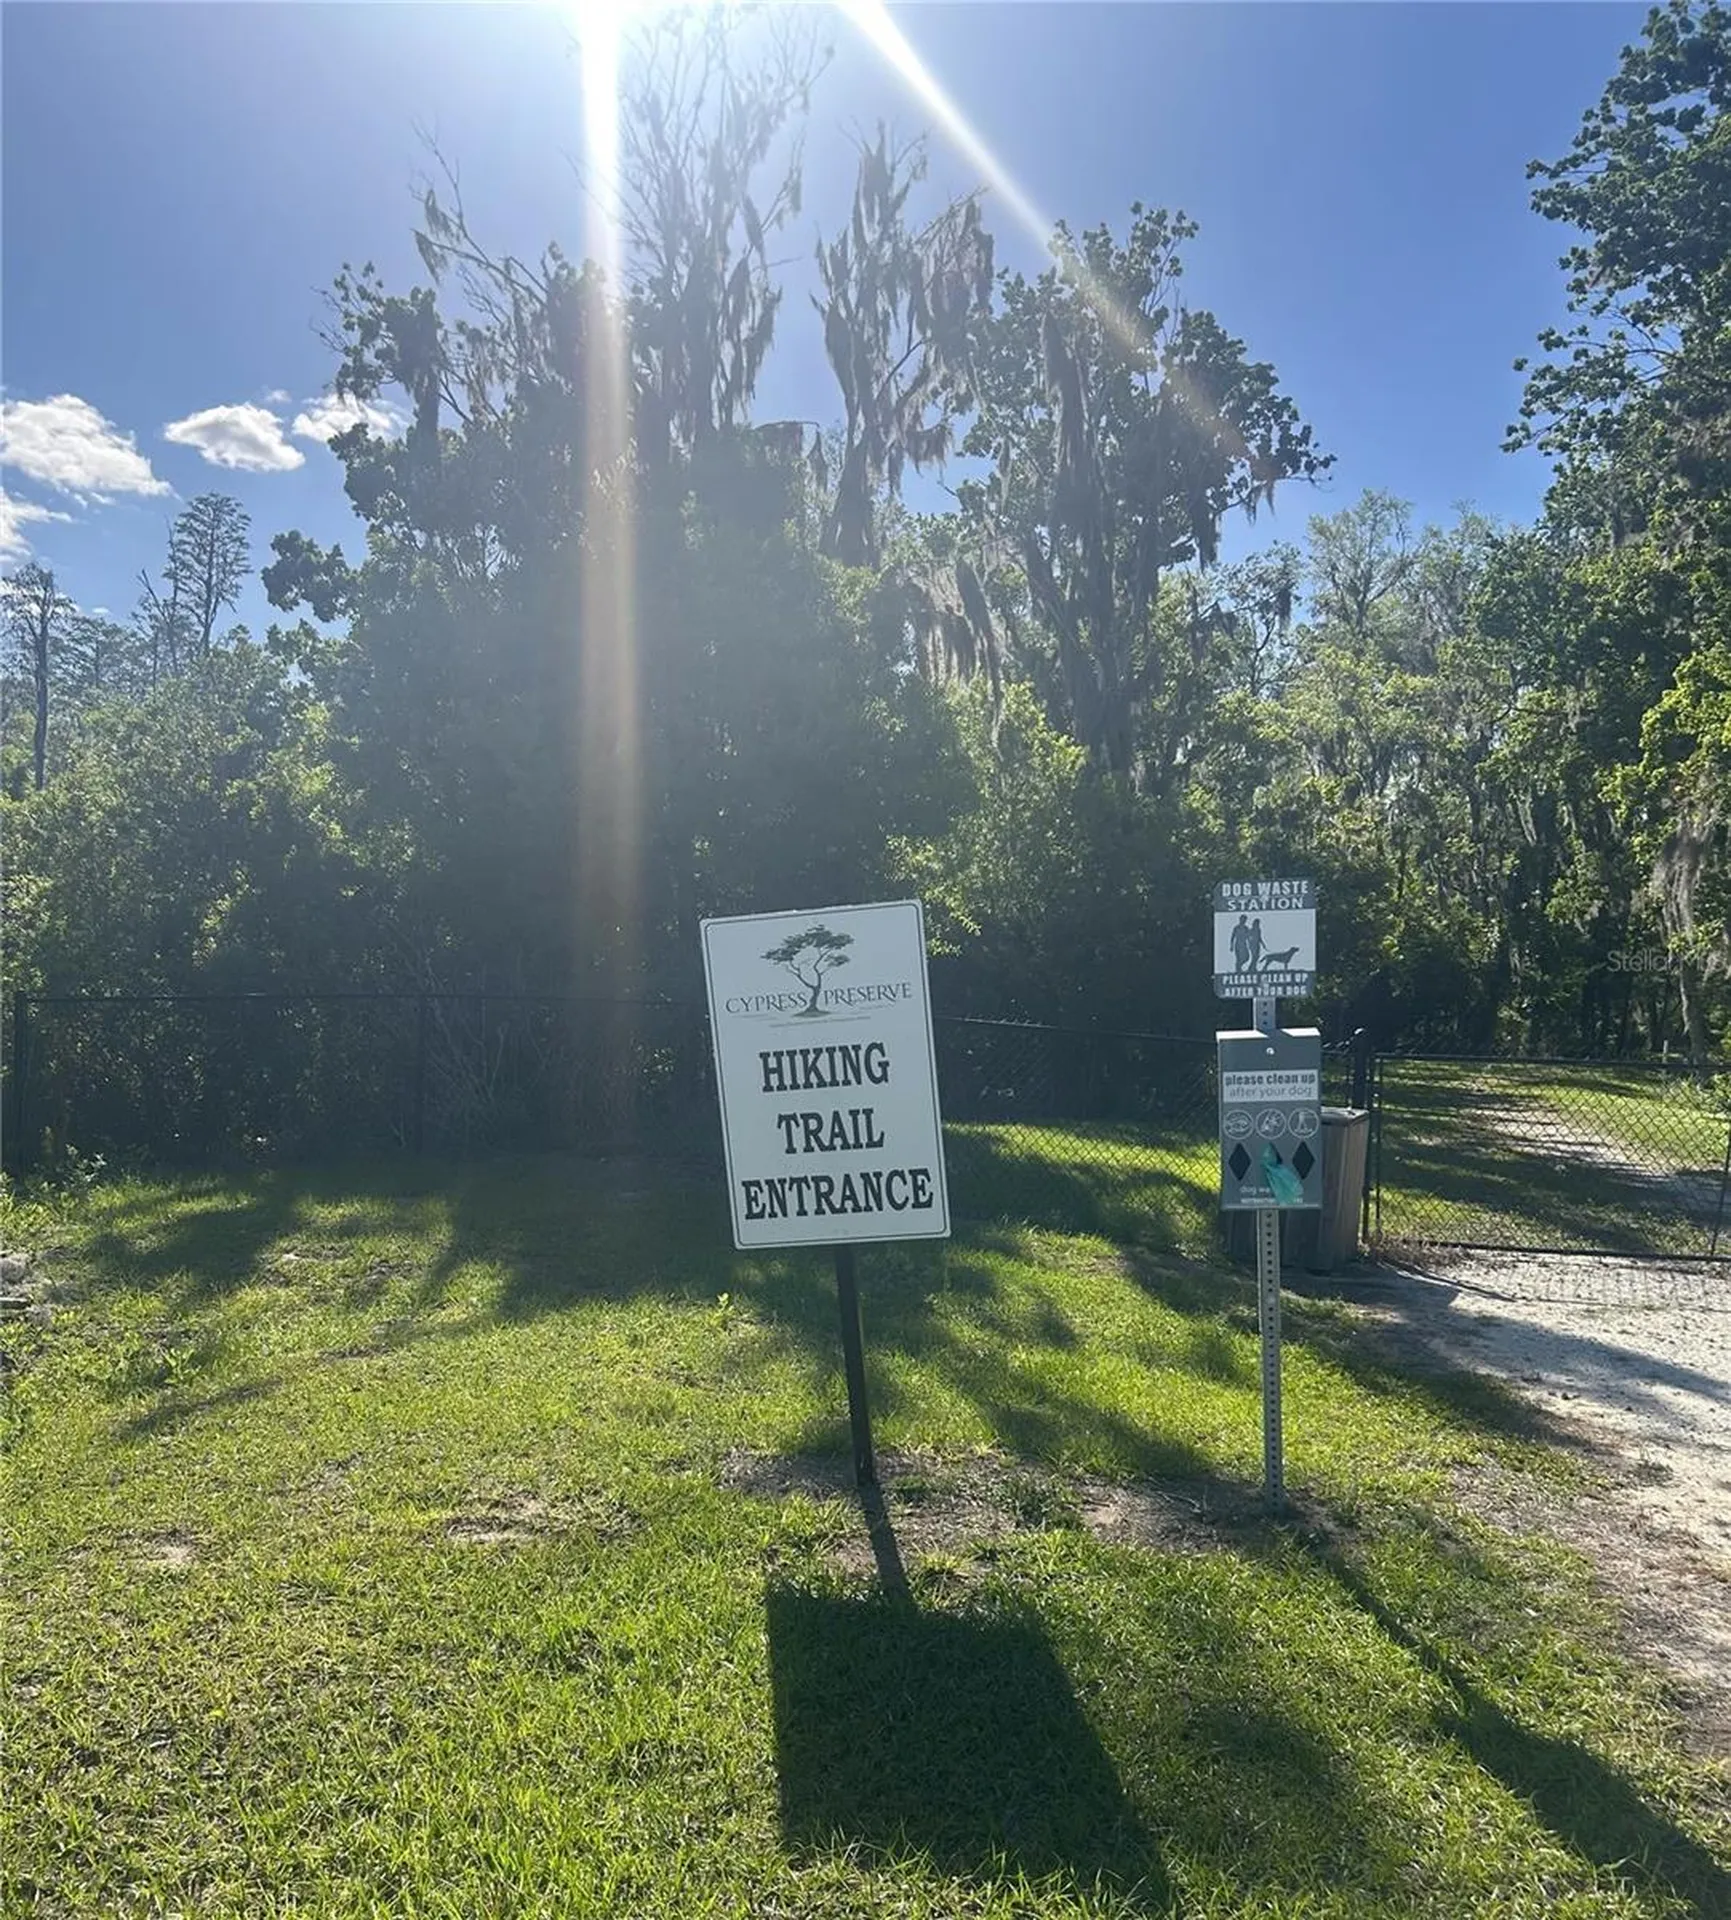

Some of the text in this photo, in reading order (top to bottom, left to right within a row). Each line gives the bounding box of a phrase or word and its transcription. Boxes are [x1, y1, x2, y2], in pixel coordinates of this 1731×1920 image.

[1222, 880, 1308, 897] DOG WASTE
[1227, 897, 1304, 911] STATION
[1223, 972, 1308, 984] PLEASE CLEAN UP
[725, 982, 913, 1014] CYPRESS PRESERVE
[1286, 985, 1307, 996] DOG
[759, 1042, 890, 1092] HIKING
[1225, 1073, 1316, 1087] please clean up
[1230, 1085, 1312, 1098] after your dog
[777, 1108, 885, 1154] TRAIL
[741, 1168, 934, 1220] ENTRANCE
